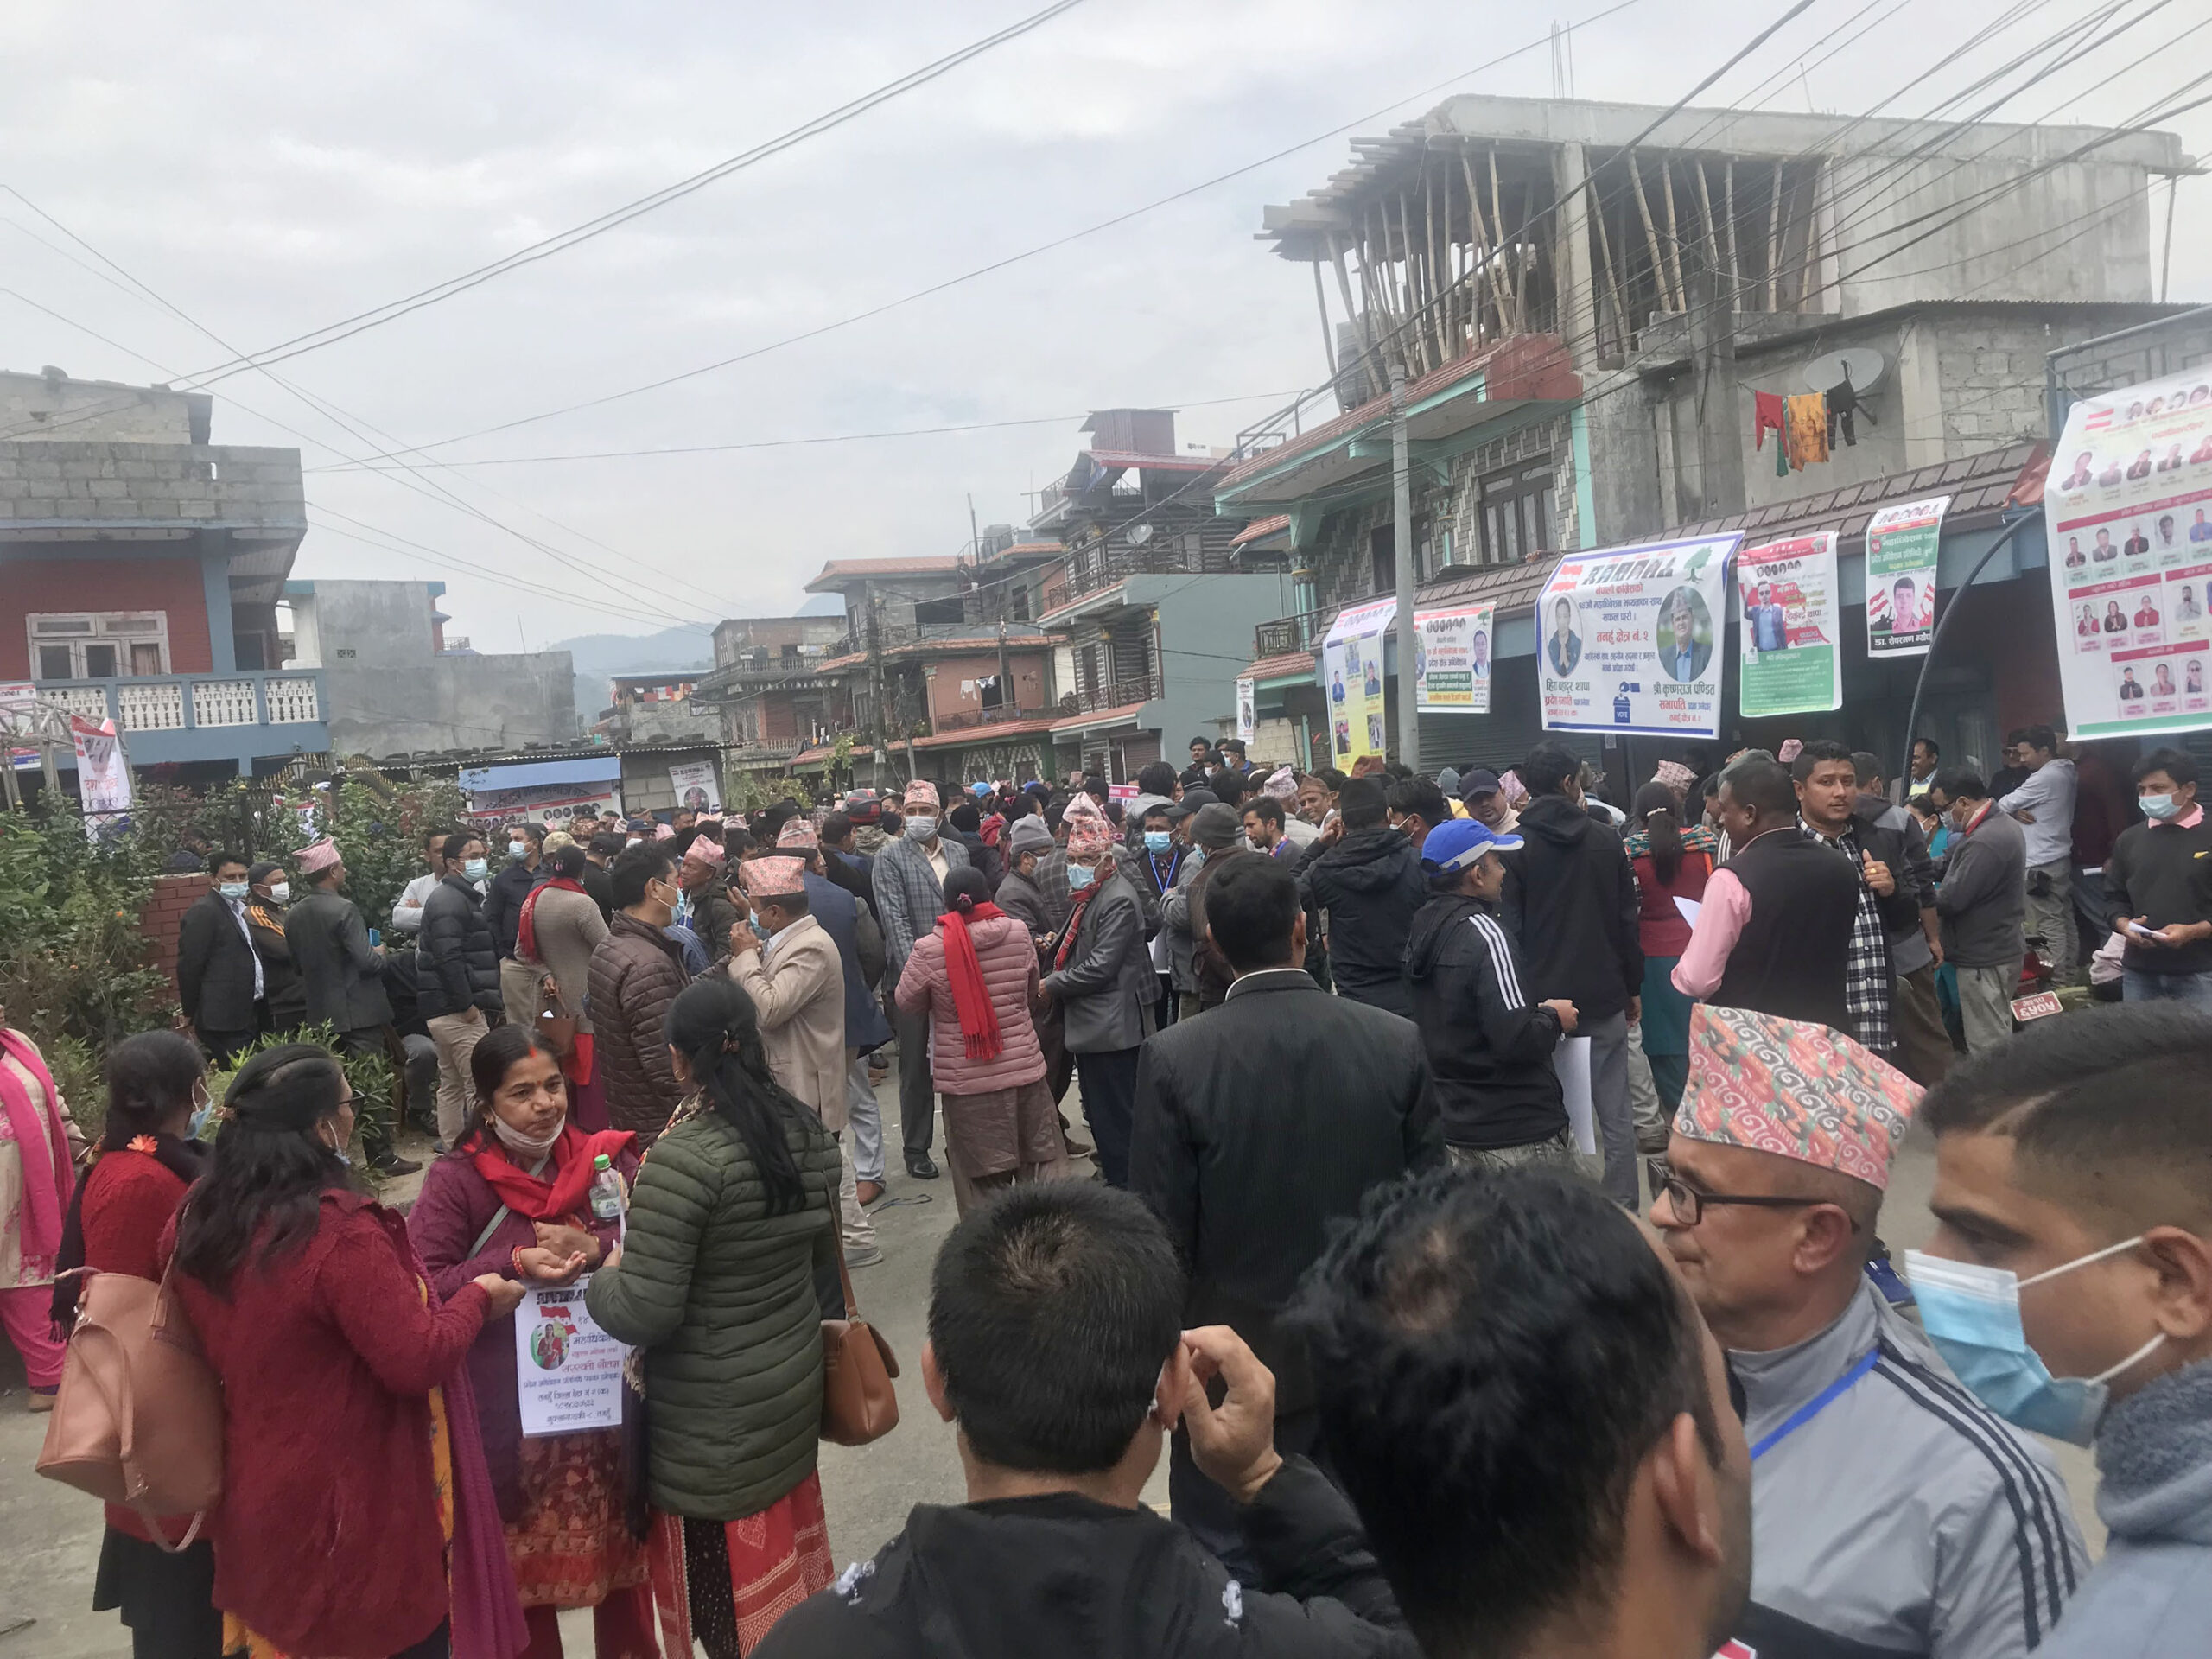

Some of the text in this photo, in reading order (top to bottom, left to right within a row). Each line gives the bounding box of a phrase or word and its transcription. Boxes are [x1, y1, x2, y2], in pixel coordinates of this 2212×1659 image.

[1593, 598, 1622, 609] महाधिवेशन
[1603, 613, 1618, 622] सफल
[1616, 629, 1630, 642] क्षेत्र
[1643, 631, 1649, 641] २
[1575, 682, 1590, 691] थापा
[1662, 684, 1692, 697] कृष्णराज
[1694, 681, 1715, 695] पण्डित
[1659, 697, 1686, 710] सभापति
[2019, 1001, 2056, 1017] ६५०५
